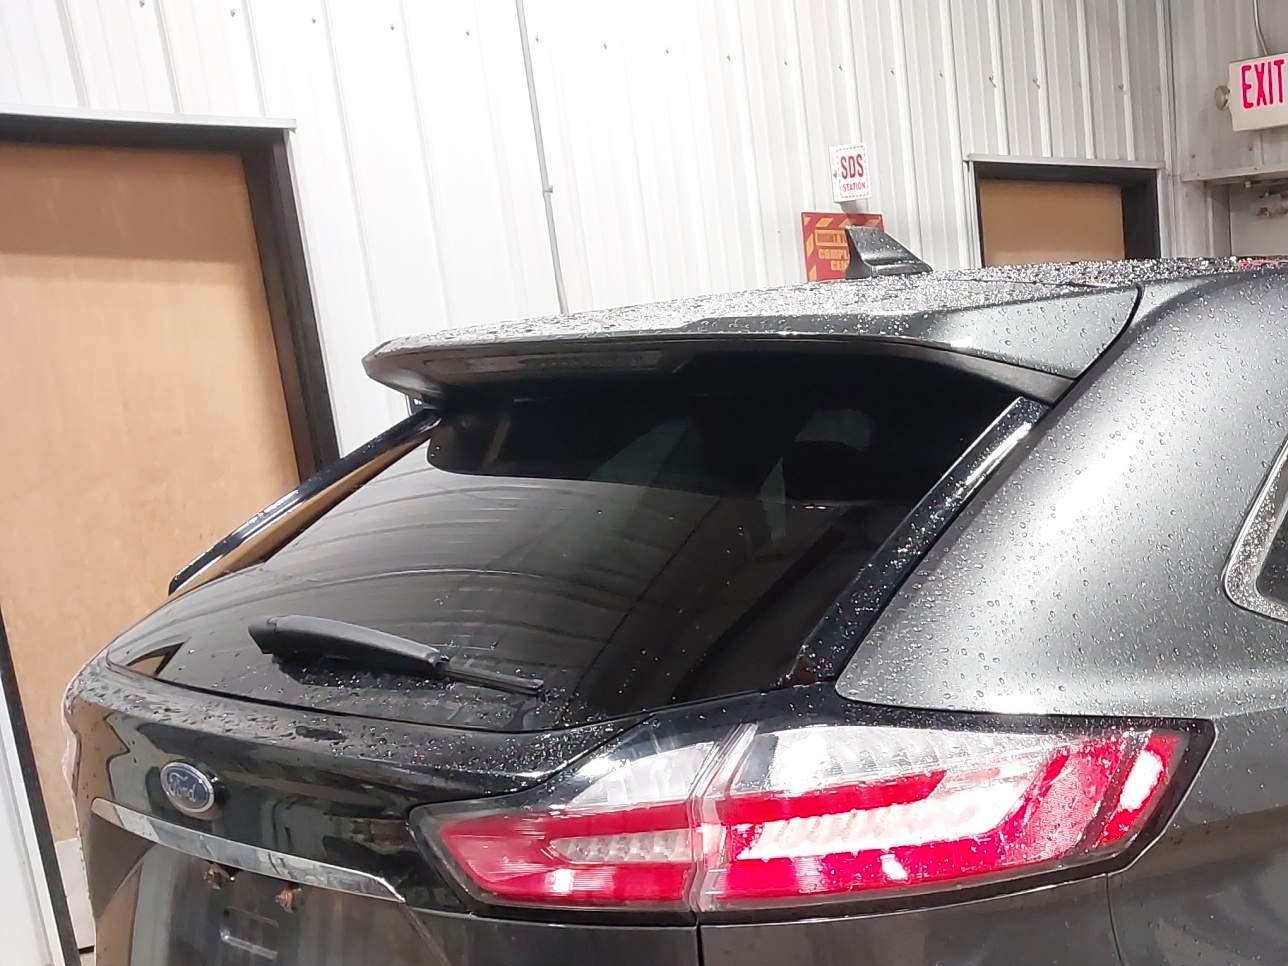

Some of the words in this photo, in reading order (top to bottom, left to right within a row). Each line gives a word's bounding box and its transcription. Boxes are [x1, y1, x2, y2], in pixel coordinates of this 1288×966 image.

[1241, 59, 1285, 109] EXIT
[840, 153, 864, 179] SDS
[842, 181, 866, 192] STATION
